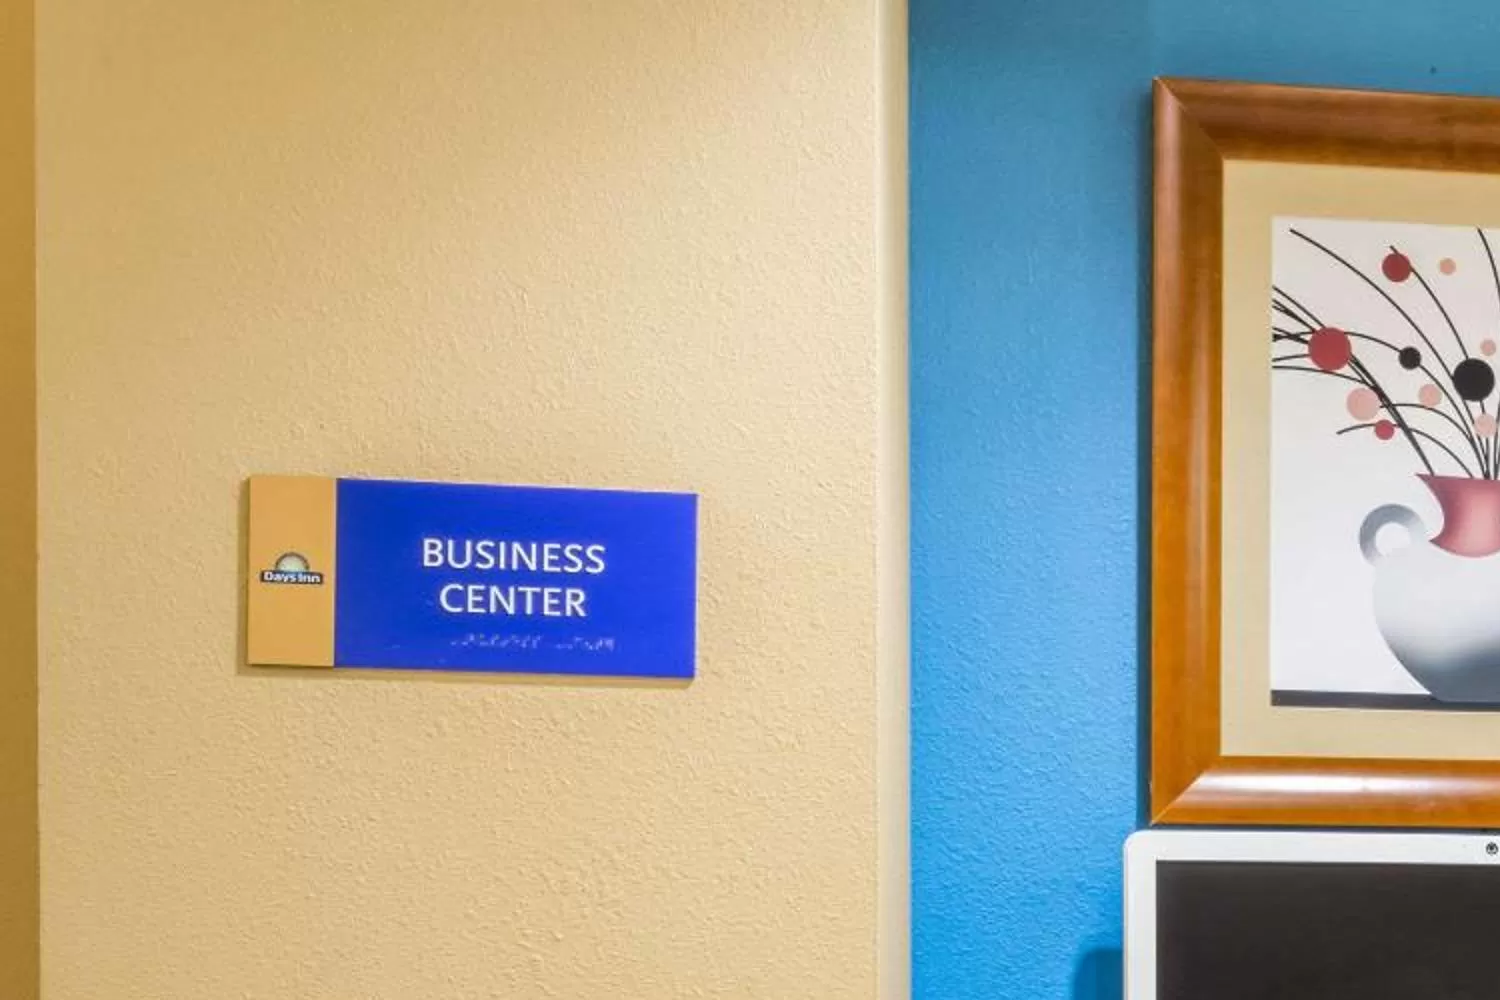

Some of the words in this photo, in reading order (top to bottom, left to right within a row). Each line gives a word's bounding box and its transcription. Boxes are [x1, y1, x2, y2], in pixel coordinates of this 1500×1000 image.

[422, 537, 606, 575] BUSINESS
[263, 571, 297, 583] Days
[298, 572, 321, 583] Inn
[438, 583, 587, 617] CENTER
